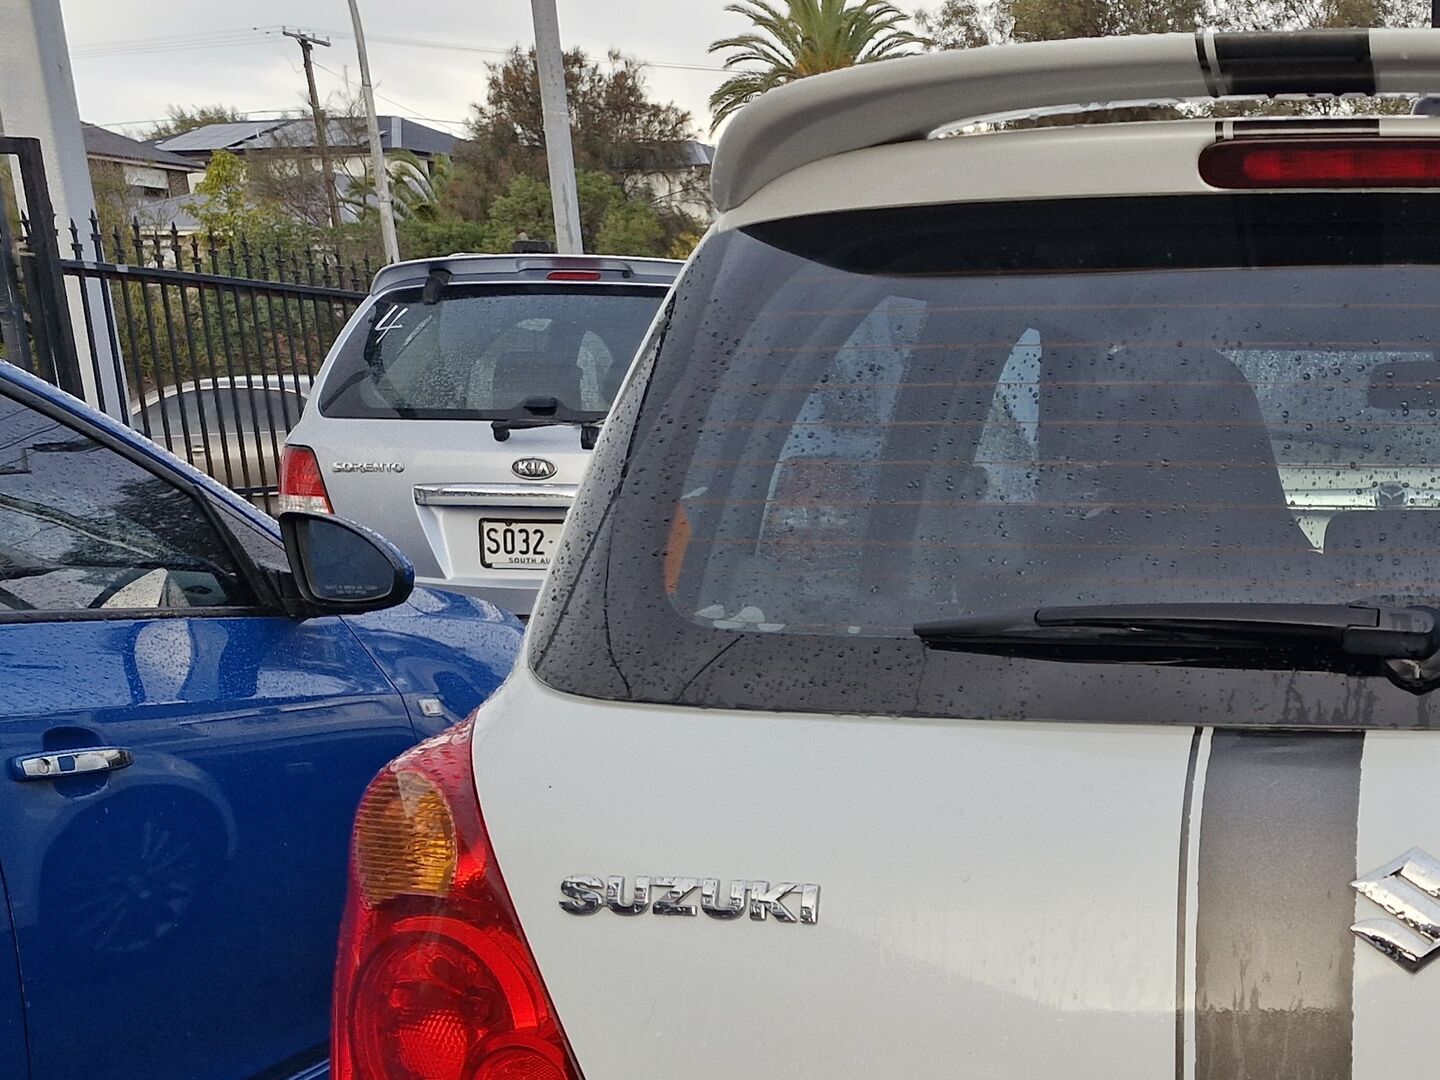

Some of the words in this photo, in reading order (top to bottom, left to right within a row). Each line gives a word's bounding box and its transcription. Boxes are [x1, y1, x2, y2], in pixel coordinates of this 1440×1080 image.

[374, 304, 409, 345] 4
[332, 462, 405, 474] SORENTO
[517, 460, 551, 476] KIA
[559, 874, 821, 925] SUZUKI
